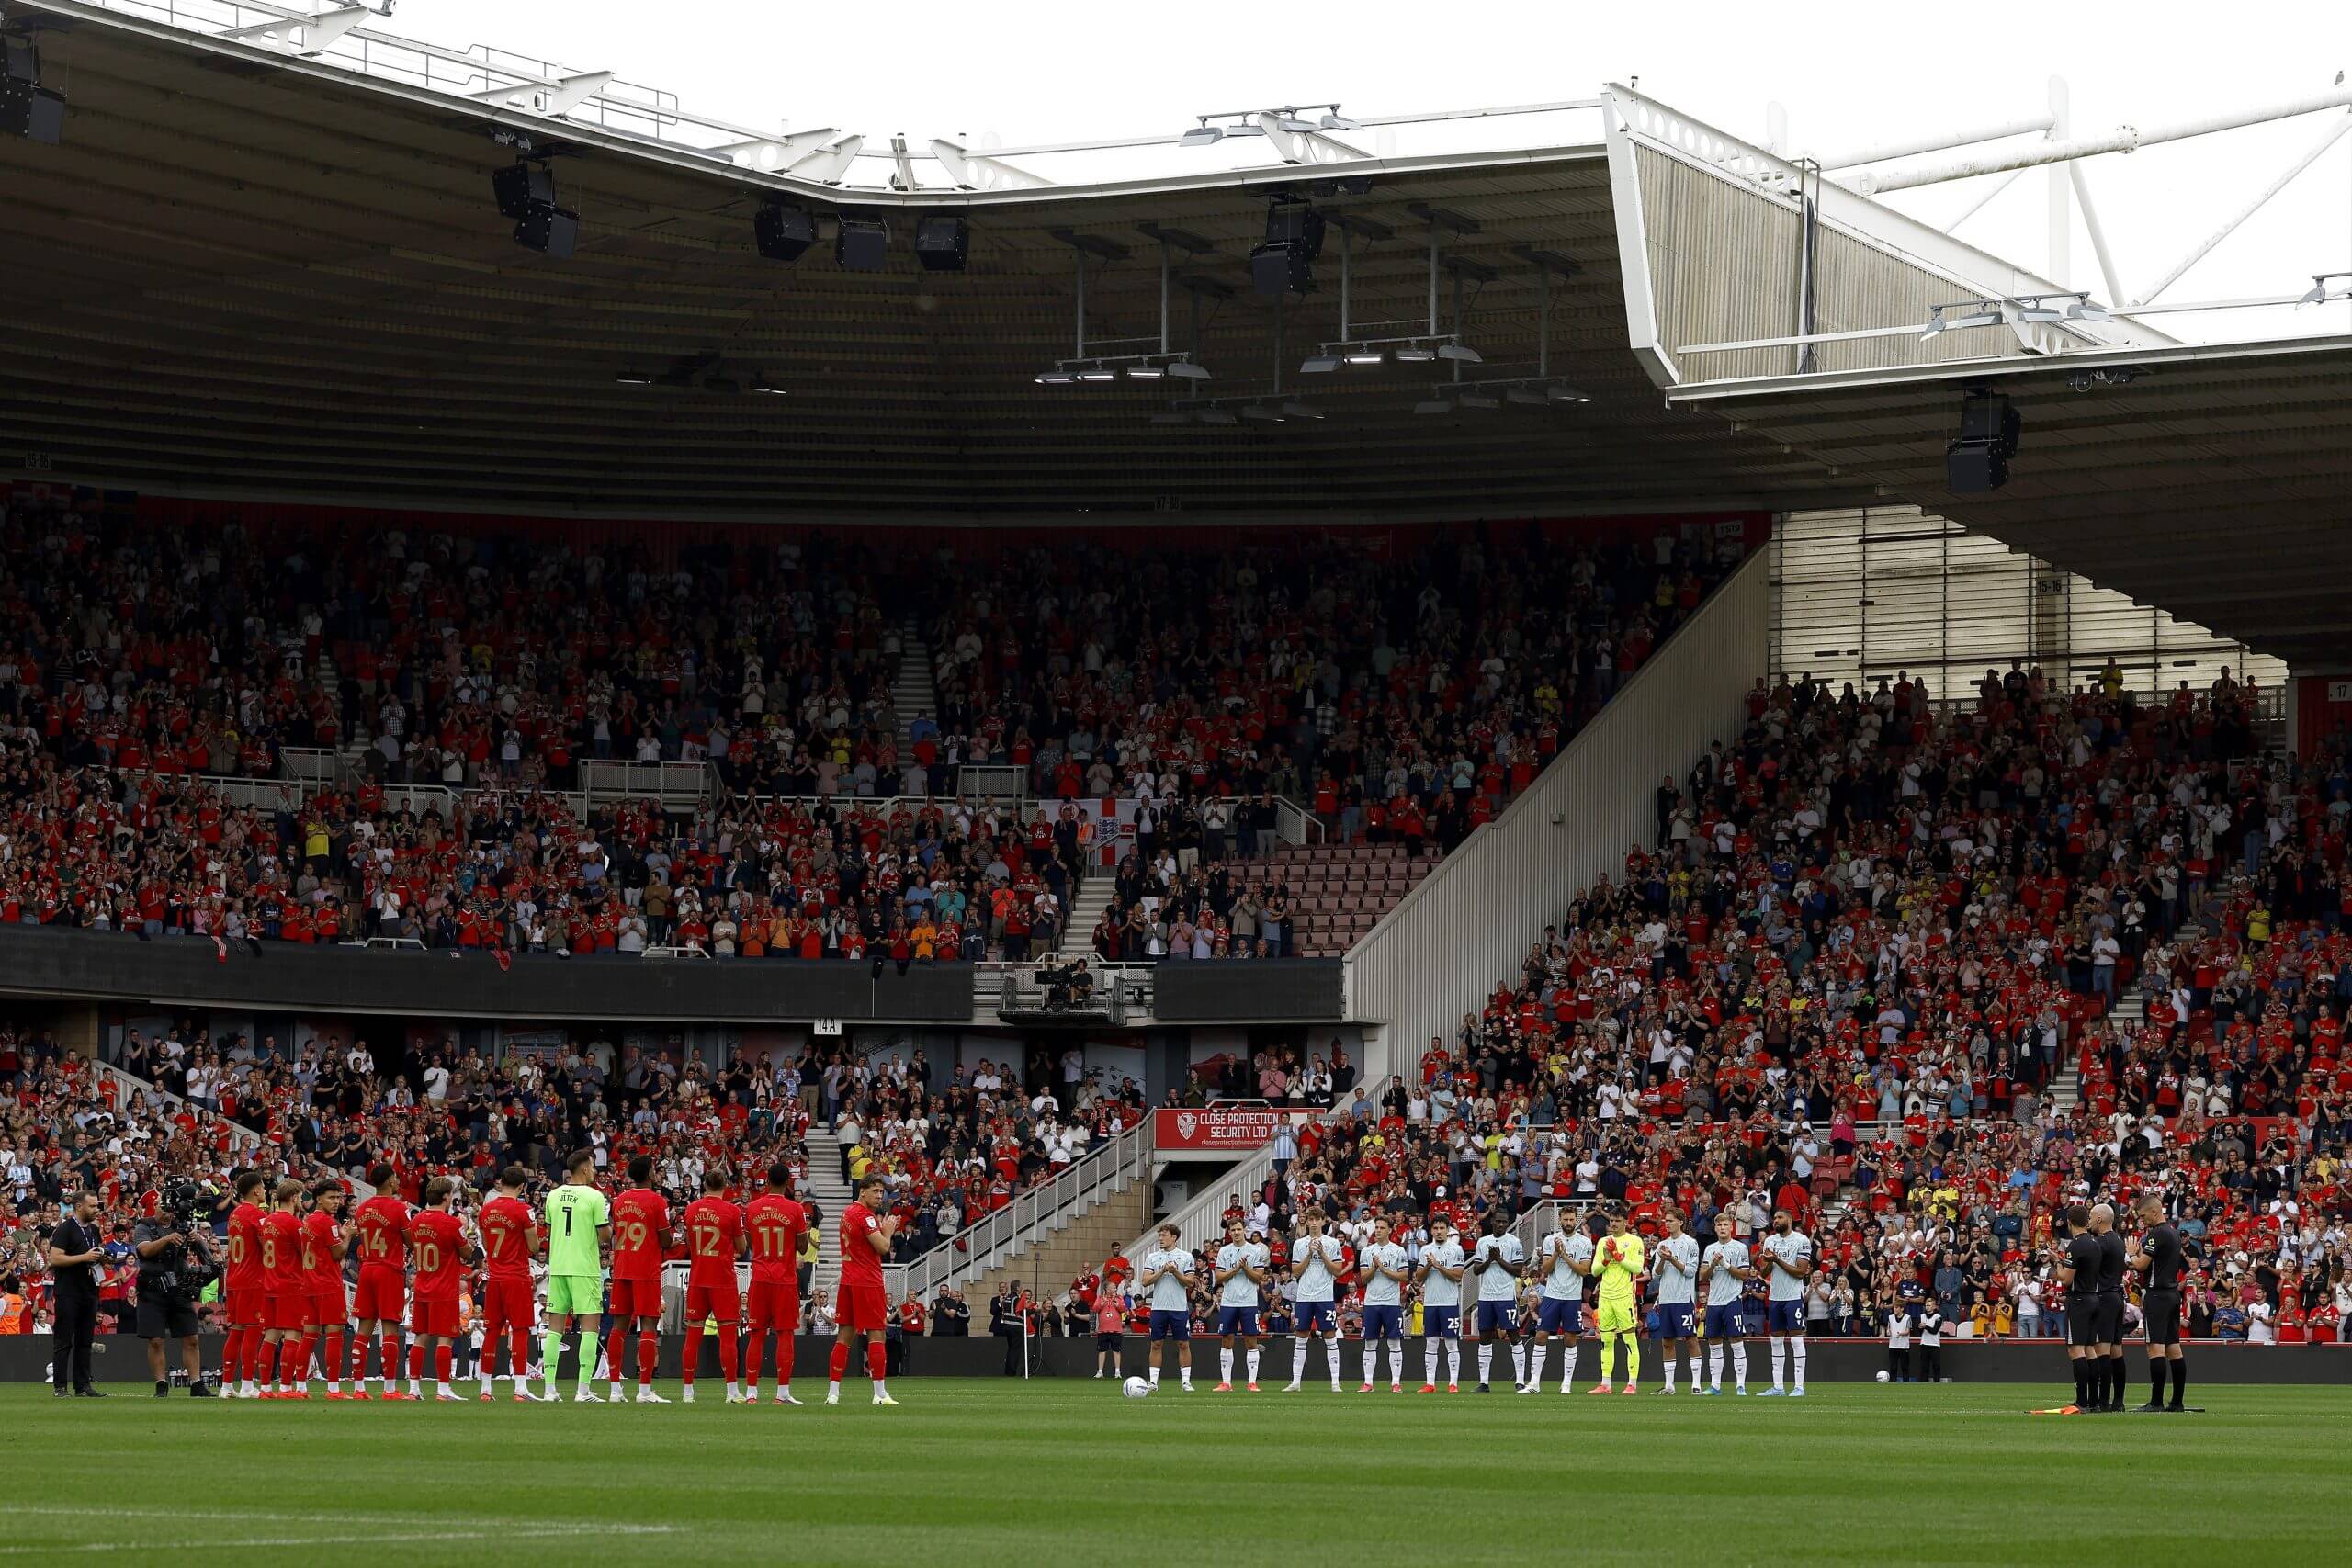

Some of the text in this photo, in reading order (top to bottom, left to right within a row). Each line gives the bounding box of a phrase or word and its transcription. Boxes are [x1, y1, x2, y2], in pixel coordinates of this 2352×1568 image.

[2038, 580, 2062, 592] 15-16
[2337, 684, 2346, 698] 17
[1200, 1112, 1279, 1125] CLOSE PROTECTION
[1210, 1126, 1268, 1138] SECURITY LTD
[562, 1207, 572, 1237] 1
[695, 1213, 720, 1224] AYLING
[359, 1228, 388, 1258] 14
[490, 1228, 506, 1258] 7
[616, 1221, 648, 1252] 29
[692, 1224, 721, 1257] 12
[758, 1226, 785, 1258] 11
[264, 1240, 276, 1269] 8
[413, 1242, 440, 1272] 10
[1325, 1309, 1337, 1322] 29
[1506, 1309, 1517, 1321] 17
[1681, 1314, 1693, 1326] 21
[1794, 1308, 1802, 1319] 6
[1447, 1317, 1459, 1329] 25
[1733, 1315, 1743, 1327] 11
